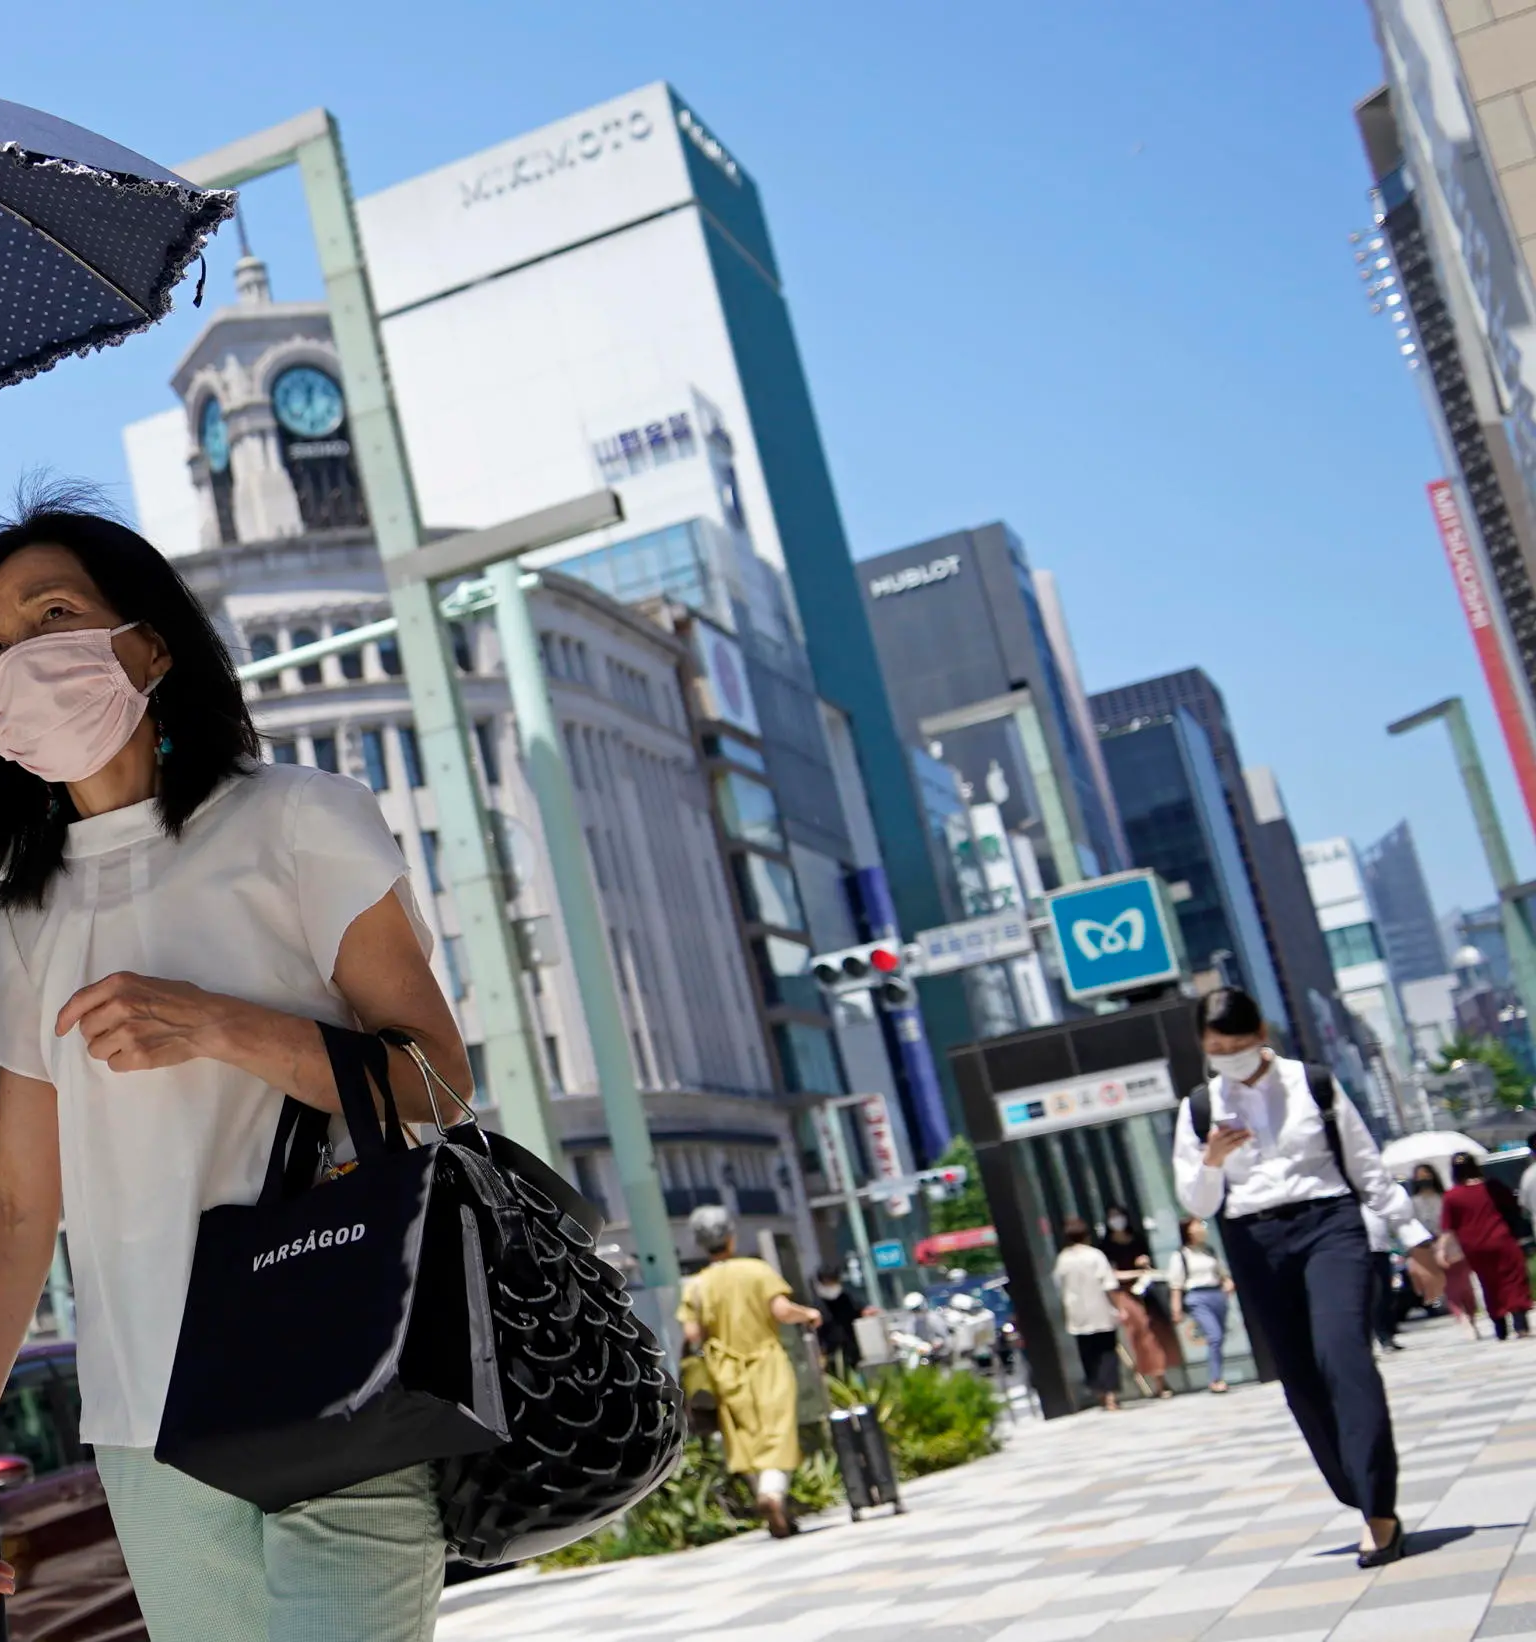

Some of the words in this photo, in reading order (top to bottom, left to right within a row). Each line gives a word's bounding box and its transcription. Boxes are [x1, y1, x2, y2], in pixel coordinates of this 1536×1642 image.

[459, 109, 653, 209] MIKIMOTO
[869, 554, 961, 599] HUBLOT
[253, 1223, 366, 1272] VARSÅGOD
